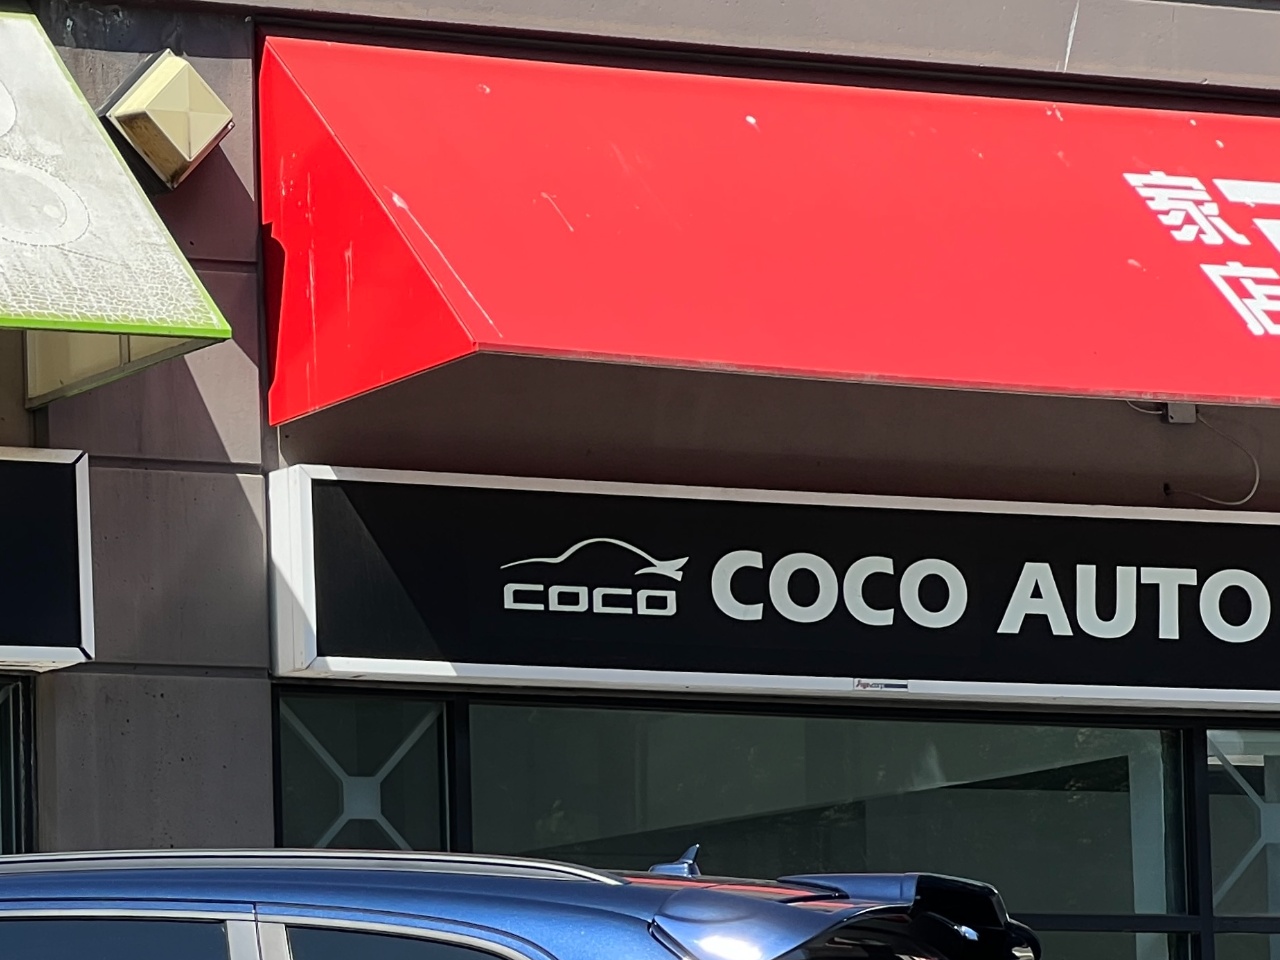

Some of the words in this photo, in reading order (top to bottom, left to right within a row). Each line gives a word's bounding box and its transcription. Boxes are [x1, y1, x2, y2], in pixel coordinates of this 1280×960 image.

[1122, 170, 1252, 246] 家
[503, 583, 677, 616] COCO
[711, 550, 968, 629] COCO
[996, 561, 1271, 643] AUTO
